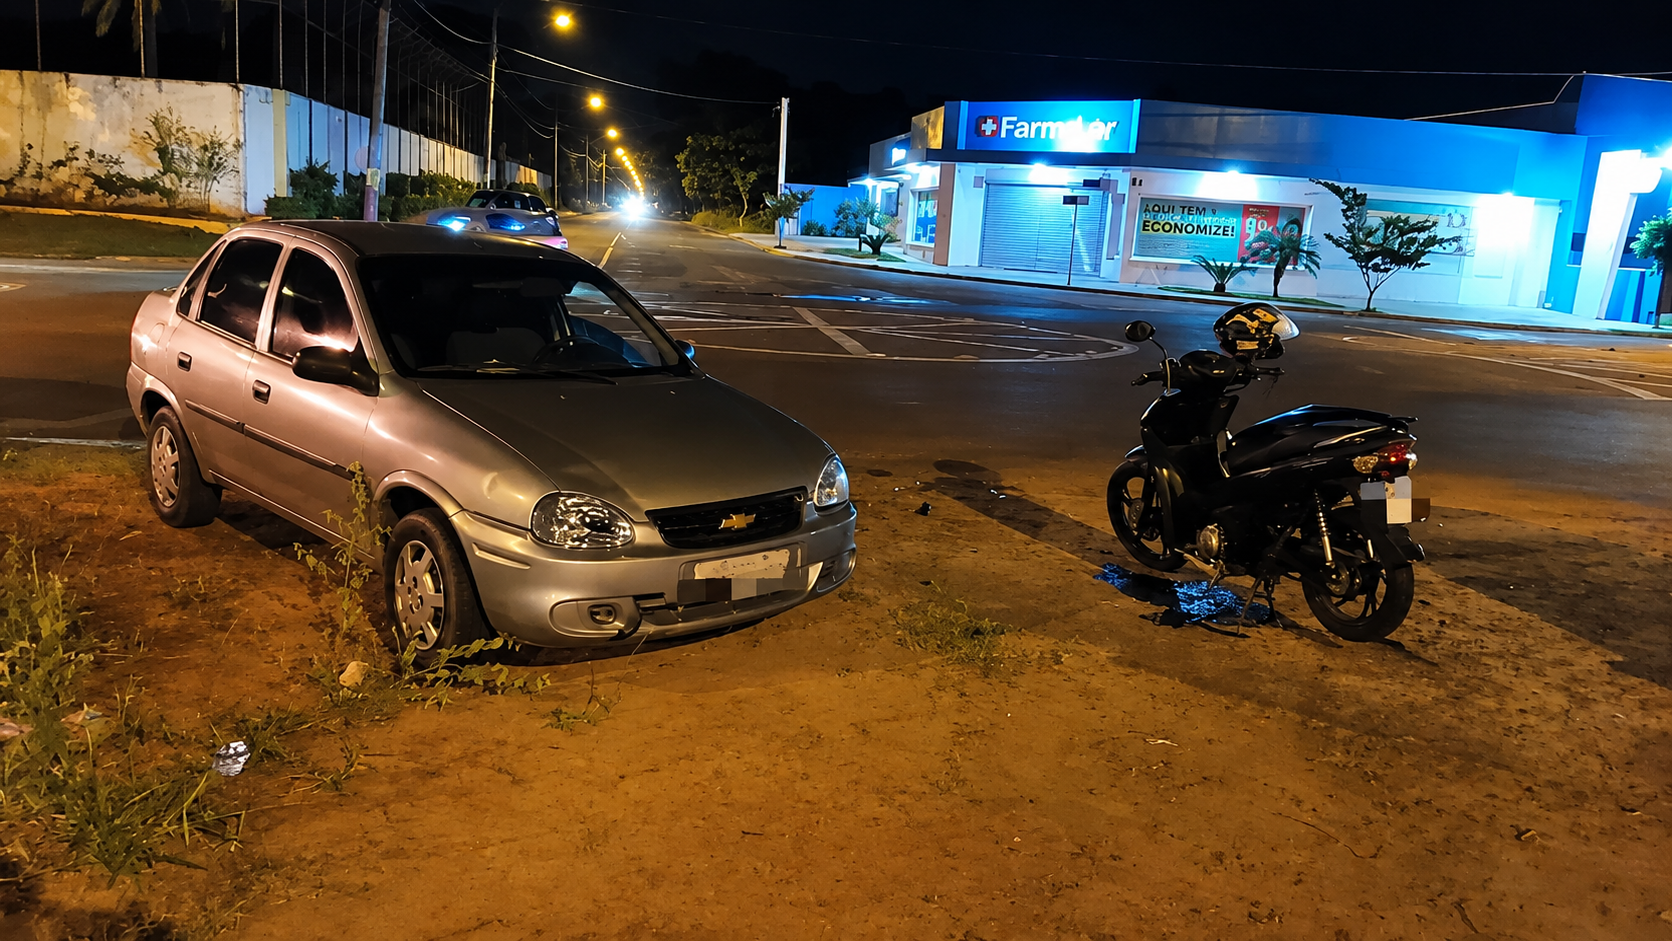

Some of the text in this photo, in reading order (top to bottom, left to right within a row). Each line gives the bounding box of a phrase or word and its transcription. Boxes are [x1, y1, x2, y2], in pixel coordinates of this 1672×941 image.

[1000, 116, 1118, 141] Farmar
[1179, 205, 1207, 216] TEM
[1141, 219, 1235, 237] ECONOMIZE!
